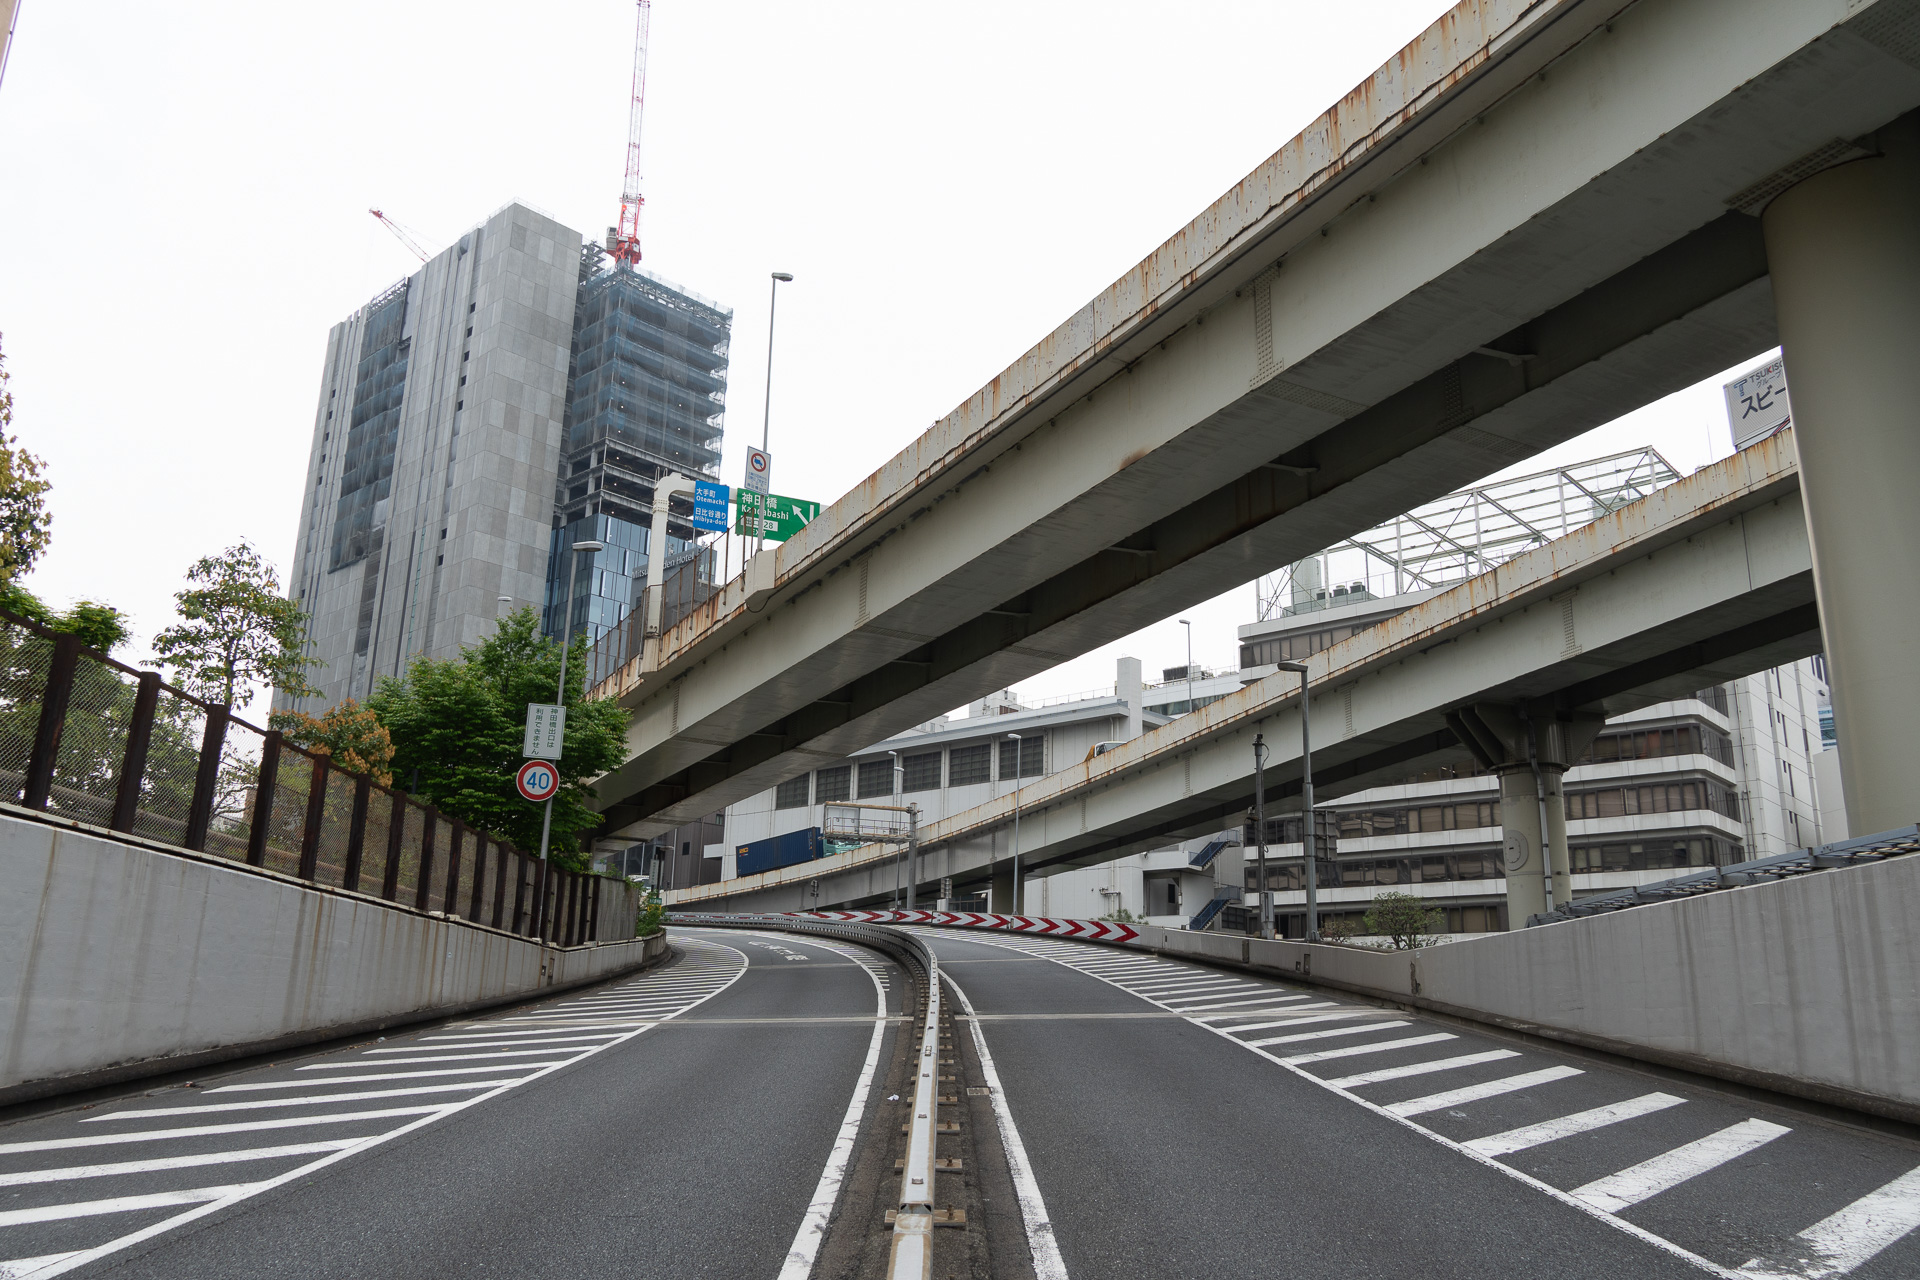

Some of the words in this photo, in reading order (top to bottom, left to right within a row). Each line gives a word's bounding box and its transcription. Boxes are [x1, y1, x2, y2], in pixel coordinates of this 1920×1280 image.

[696, 487, 716, 498] 大手町
[696, 495, 725, 505] Otemachi
[695, 507, 727, 519] 日比谷通り
[694, 515, 727, 526] Hibiya-dori
[752, 528, 767, 537] EXT
[632, 569, 649, 579] Mitsu
[676, 551, 694, 565] Hotel
[531, 707, 544, 756] 利用できません
[546, 707, 559, 749] 神田橋出口は
[526, 771, 550, 790] 40
